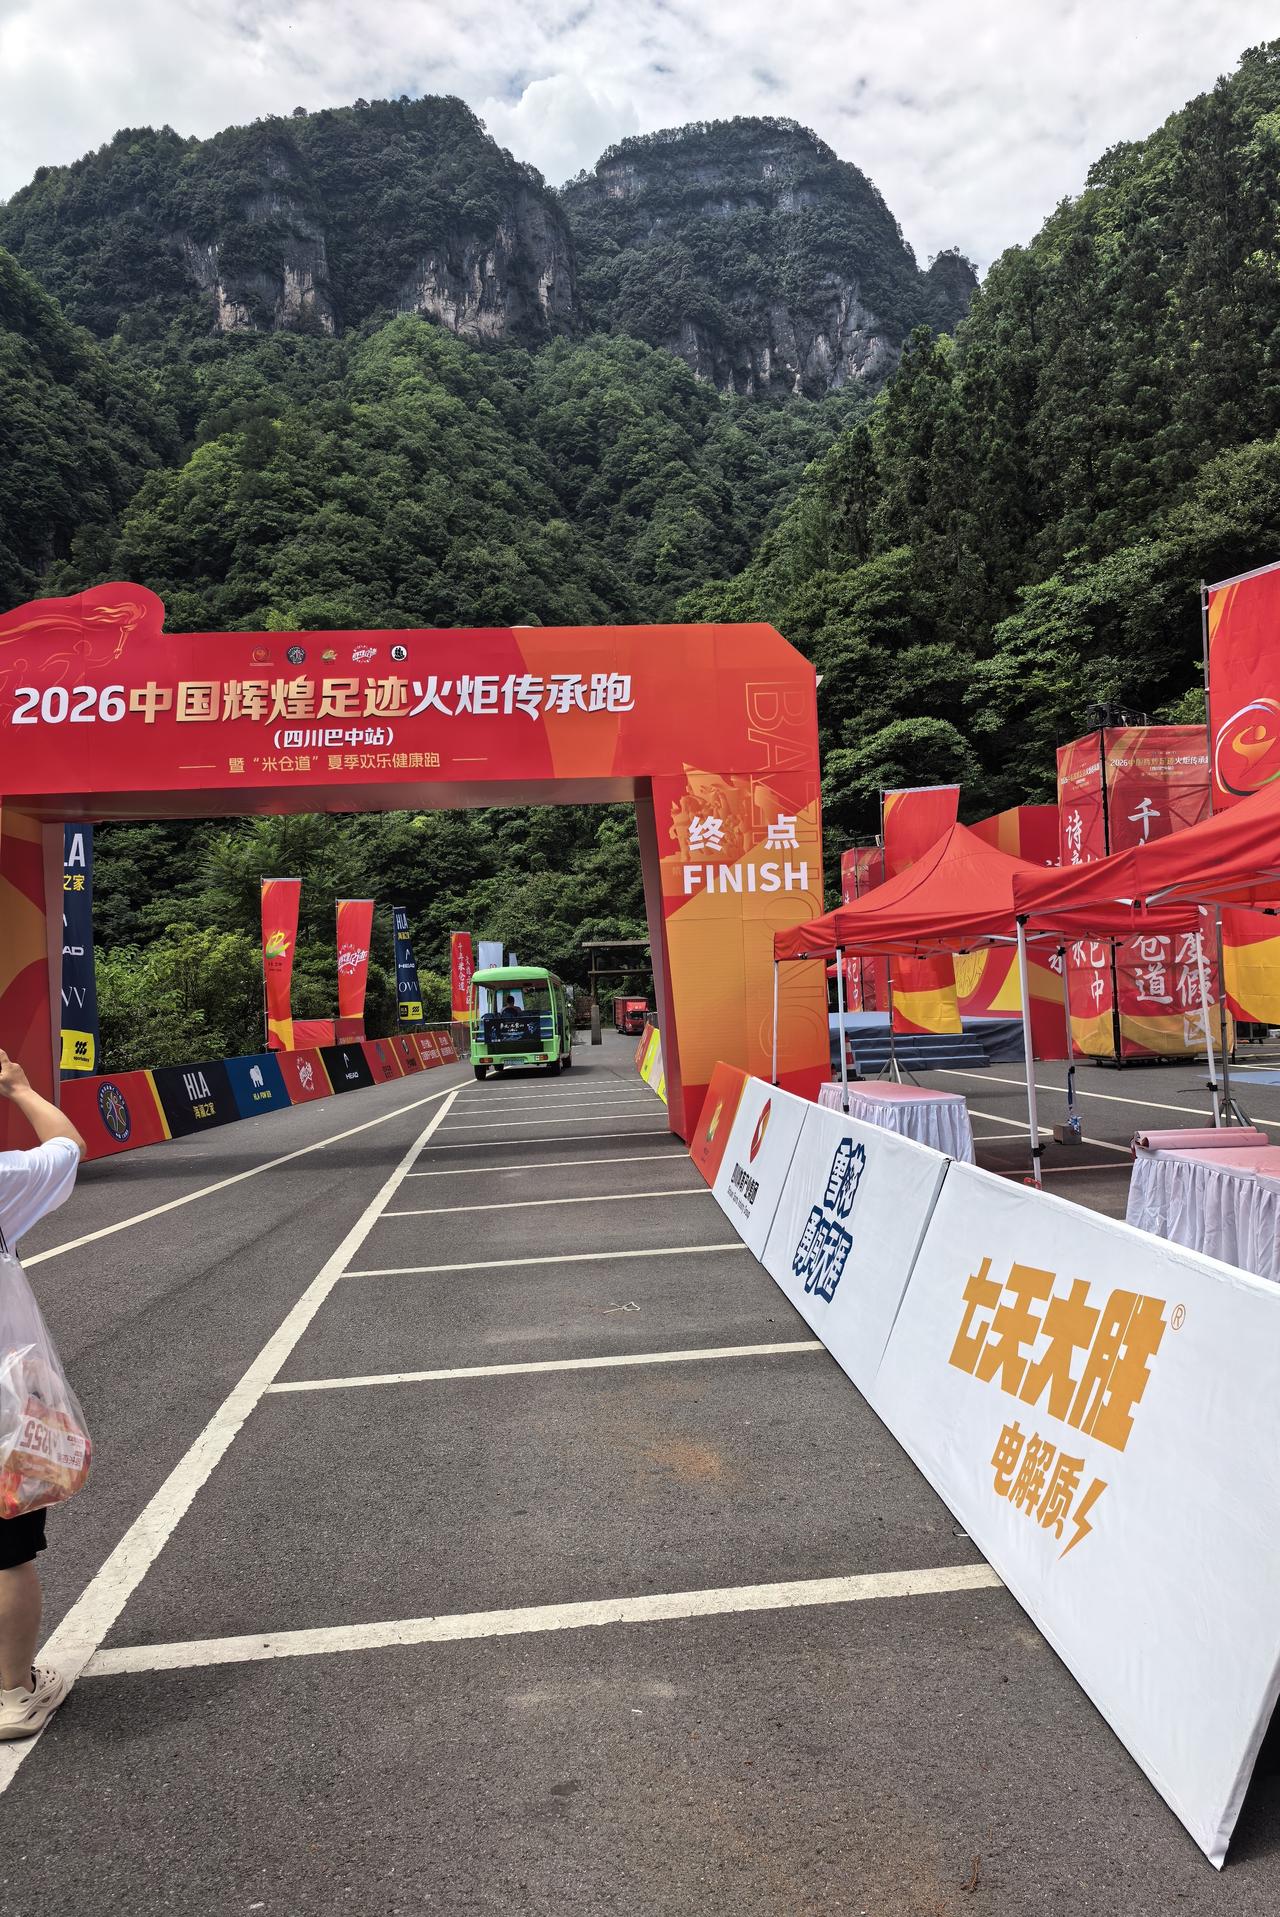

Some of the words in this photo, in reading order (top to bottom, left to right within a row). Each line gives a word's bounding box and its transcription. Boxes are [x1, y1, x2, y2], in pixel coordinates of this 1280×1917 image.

[11, 672, 635, 726] 2026中国辉煌足迹火炬传承跑
[273, 726, 394, 750] (四川巴中站)
[688, 814, 800, 852] 终点
[683, 861, 809, 895] FINISH
[182, 1071, 211, 1101] HLA
[345, 1071, 360, 1080] HEAD
[990, 1420, 1086, 1540] 电解质
